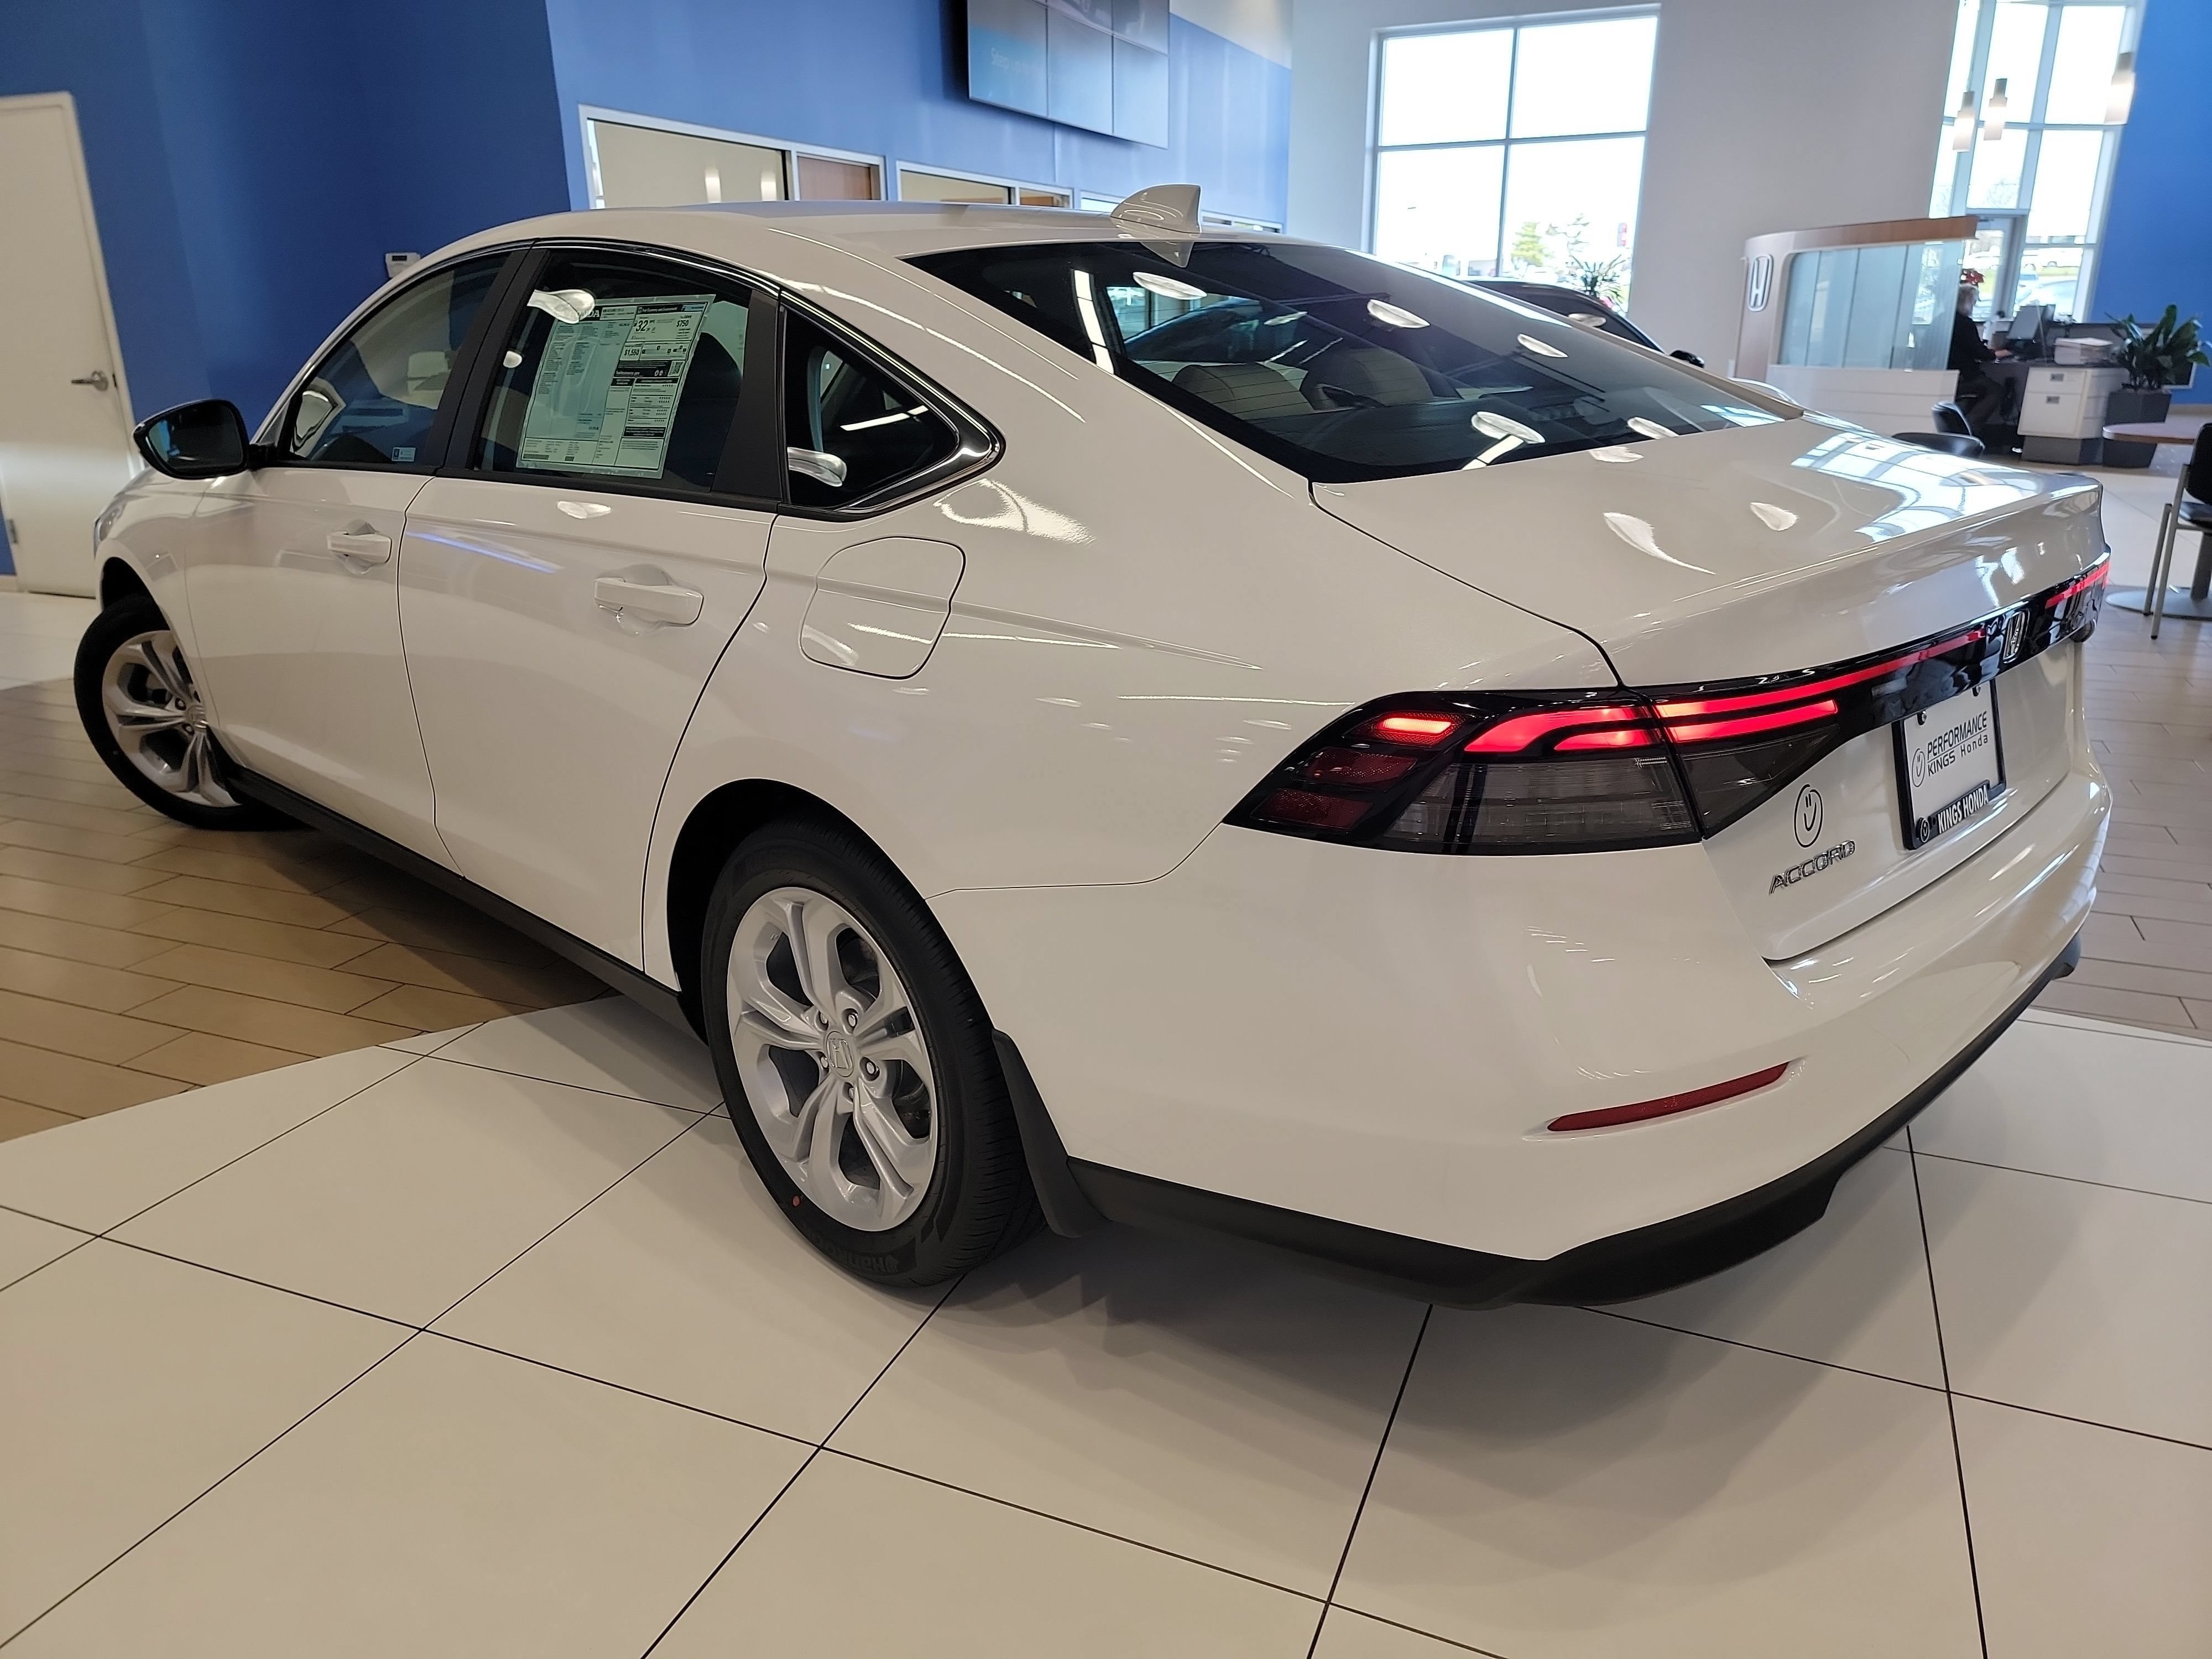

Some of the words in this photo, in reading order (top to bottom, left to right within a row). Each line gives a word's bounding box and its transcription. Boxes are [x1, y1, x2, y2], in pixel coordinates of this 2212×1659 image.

[636, 320, 649, 332] 32
[1927, 711, 1987, 760] PERFORMANCE
[1928, 750, 1955, 776] KINGS
[1960, 734, 1988, 758] Honda
[1938, 801, 1962, 834] KINGS
[1963, 785, 1989, 818] HONDA
[1768, 840, 1855, 895] ACCORD
